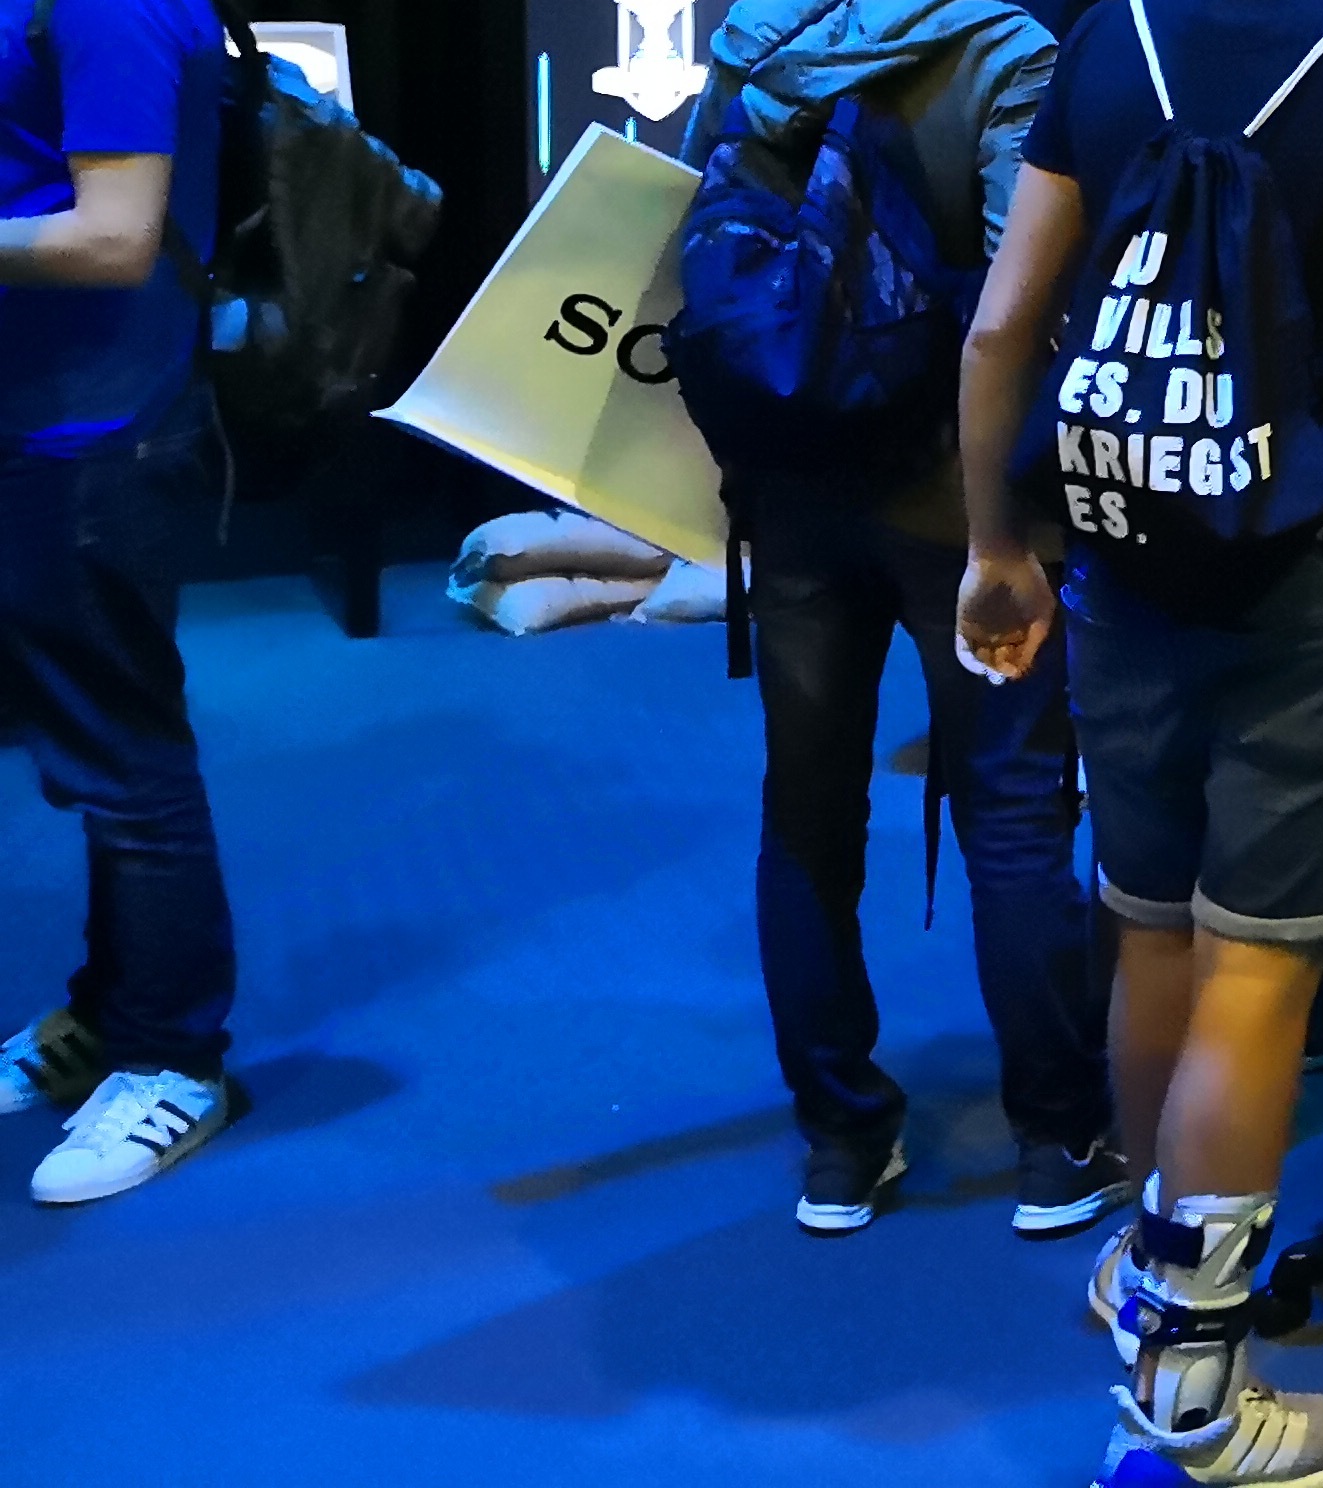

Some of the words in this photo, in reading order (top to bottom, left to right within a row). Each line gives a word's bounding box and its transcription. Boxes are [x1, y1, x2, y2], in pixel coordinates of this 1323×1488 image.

[1058, 357, 1142, 423] ES.
[1163, 367, 1234, 428] DU
[1057, 421, 1272, 496] KRIEGST
[1064, 484, 1148, 544] ES.
